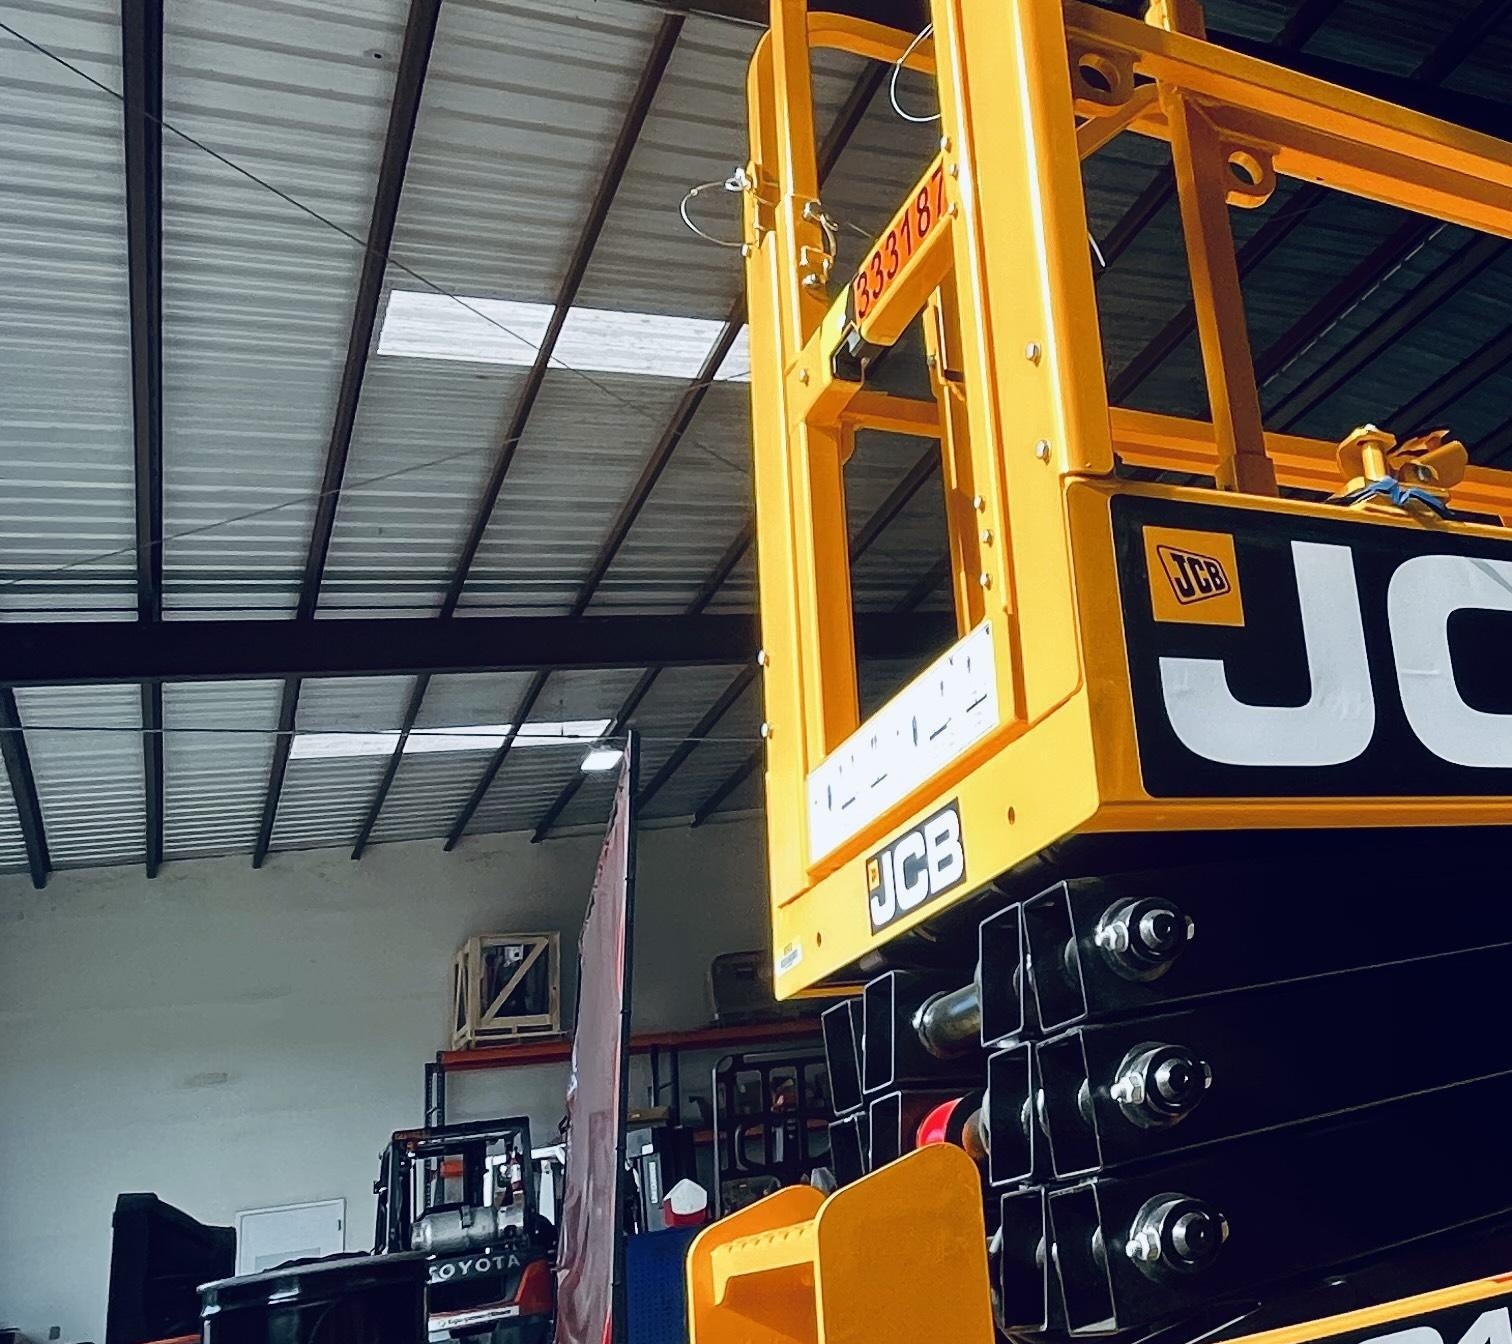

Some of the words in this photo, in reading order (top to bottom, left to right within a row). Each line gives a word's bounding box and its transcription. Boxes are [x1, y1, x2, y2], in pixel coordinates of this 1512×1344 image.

[857, 161, 943, 319] 333187
[1170, 552, 1226, 597] JCB
[870, 809, 964, 926] JCB
